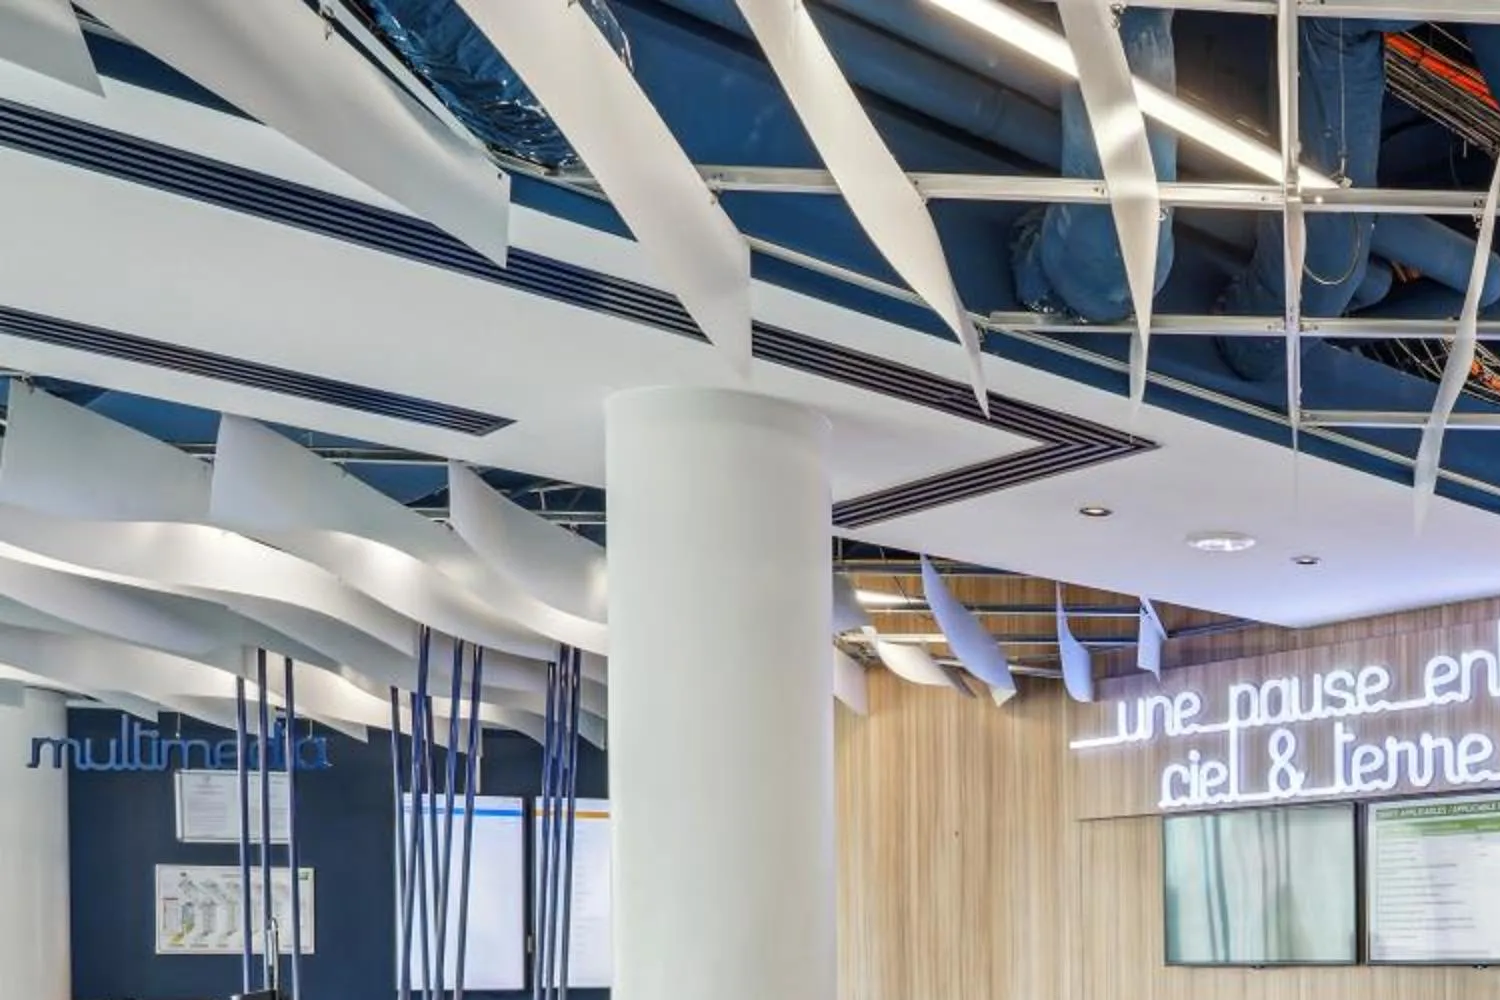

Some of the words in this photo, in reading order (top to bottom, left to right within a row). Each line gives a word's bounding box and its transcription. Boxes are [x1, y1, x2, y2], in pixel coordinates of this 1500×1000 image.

[26, 713, 334, 771] multimeda
[1117, 689, 1203, 742] une
[1228, 664, 1391, 728] pause
[1158, 727, 1243, 807] ciel
[1267, 728, 1304, 801] &
[1335, 721, 1495, 791] terre
